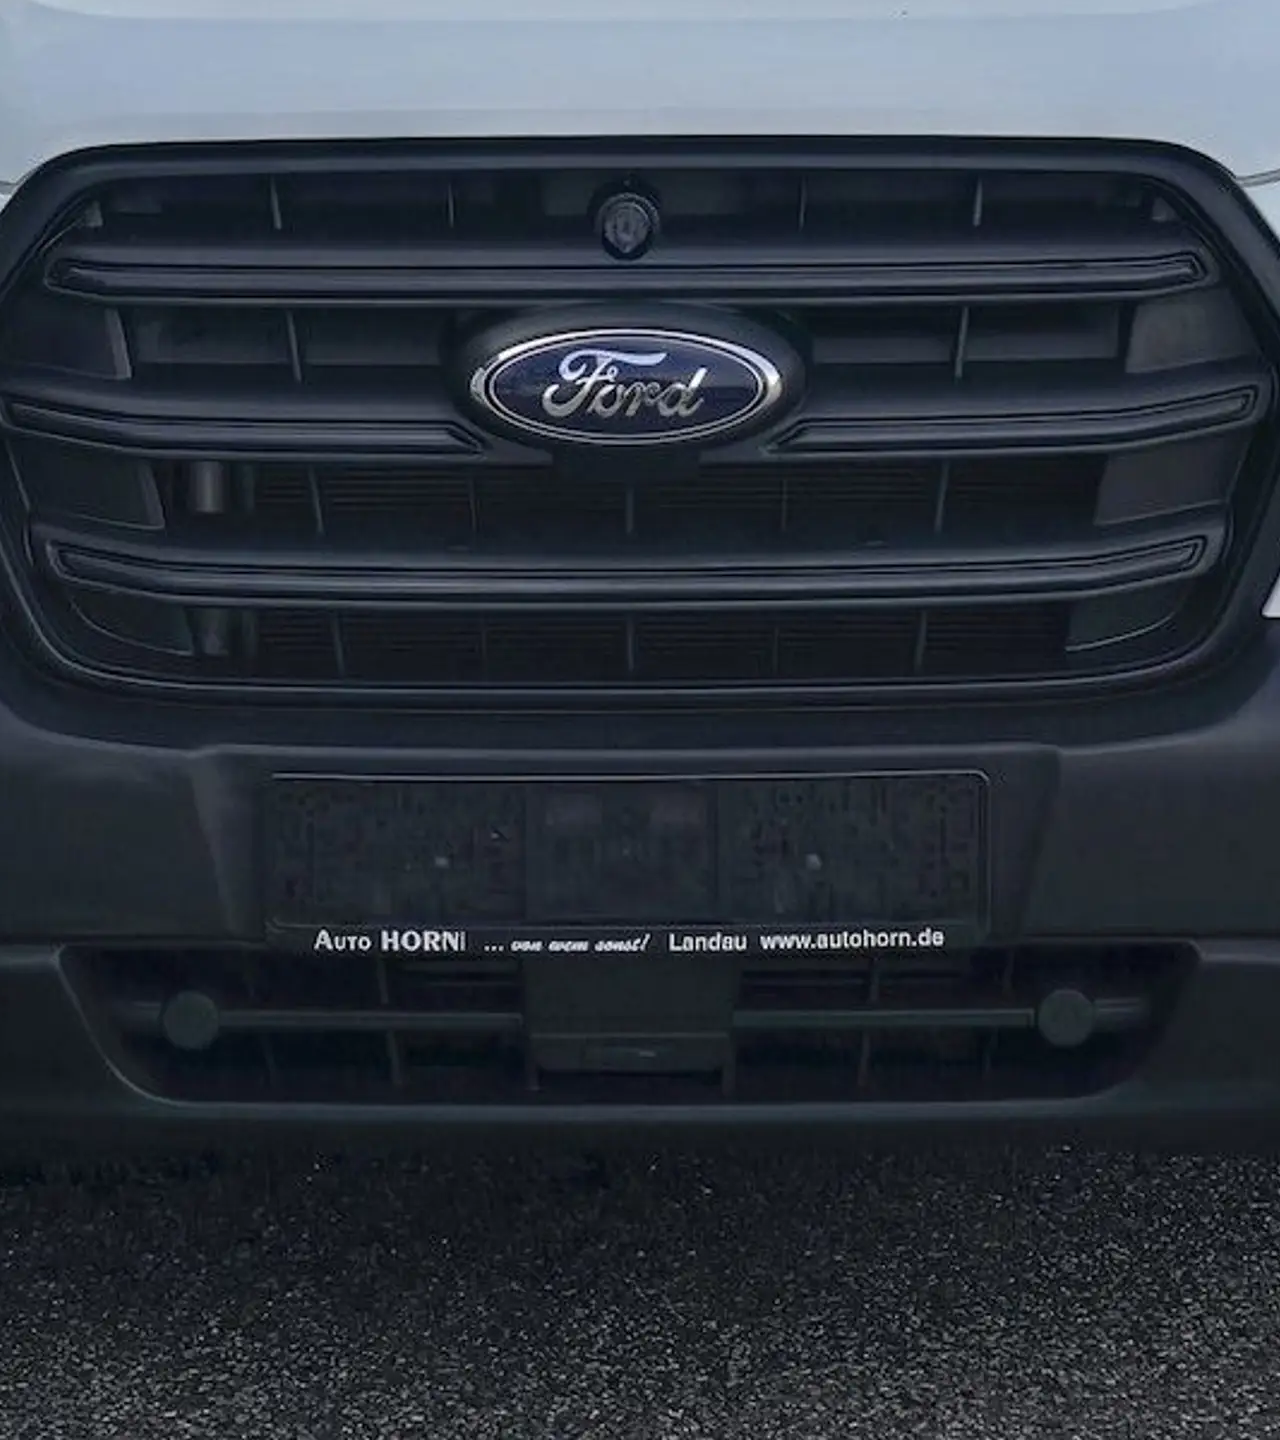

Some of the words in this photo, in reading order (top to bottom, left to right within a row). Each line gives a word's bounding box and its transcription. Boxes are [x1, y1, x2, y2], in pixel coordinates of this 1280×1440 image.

[542, 348, 707, 418] Ford
[668, 931, 748, 952] Landau
[759, 926, 945, 951] www.autohorn.de
